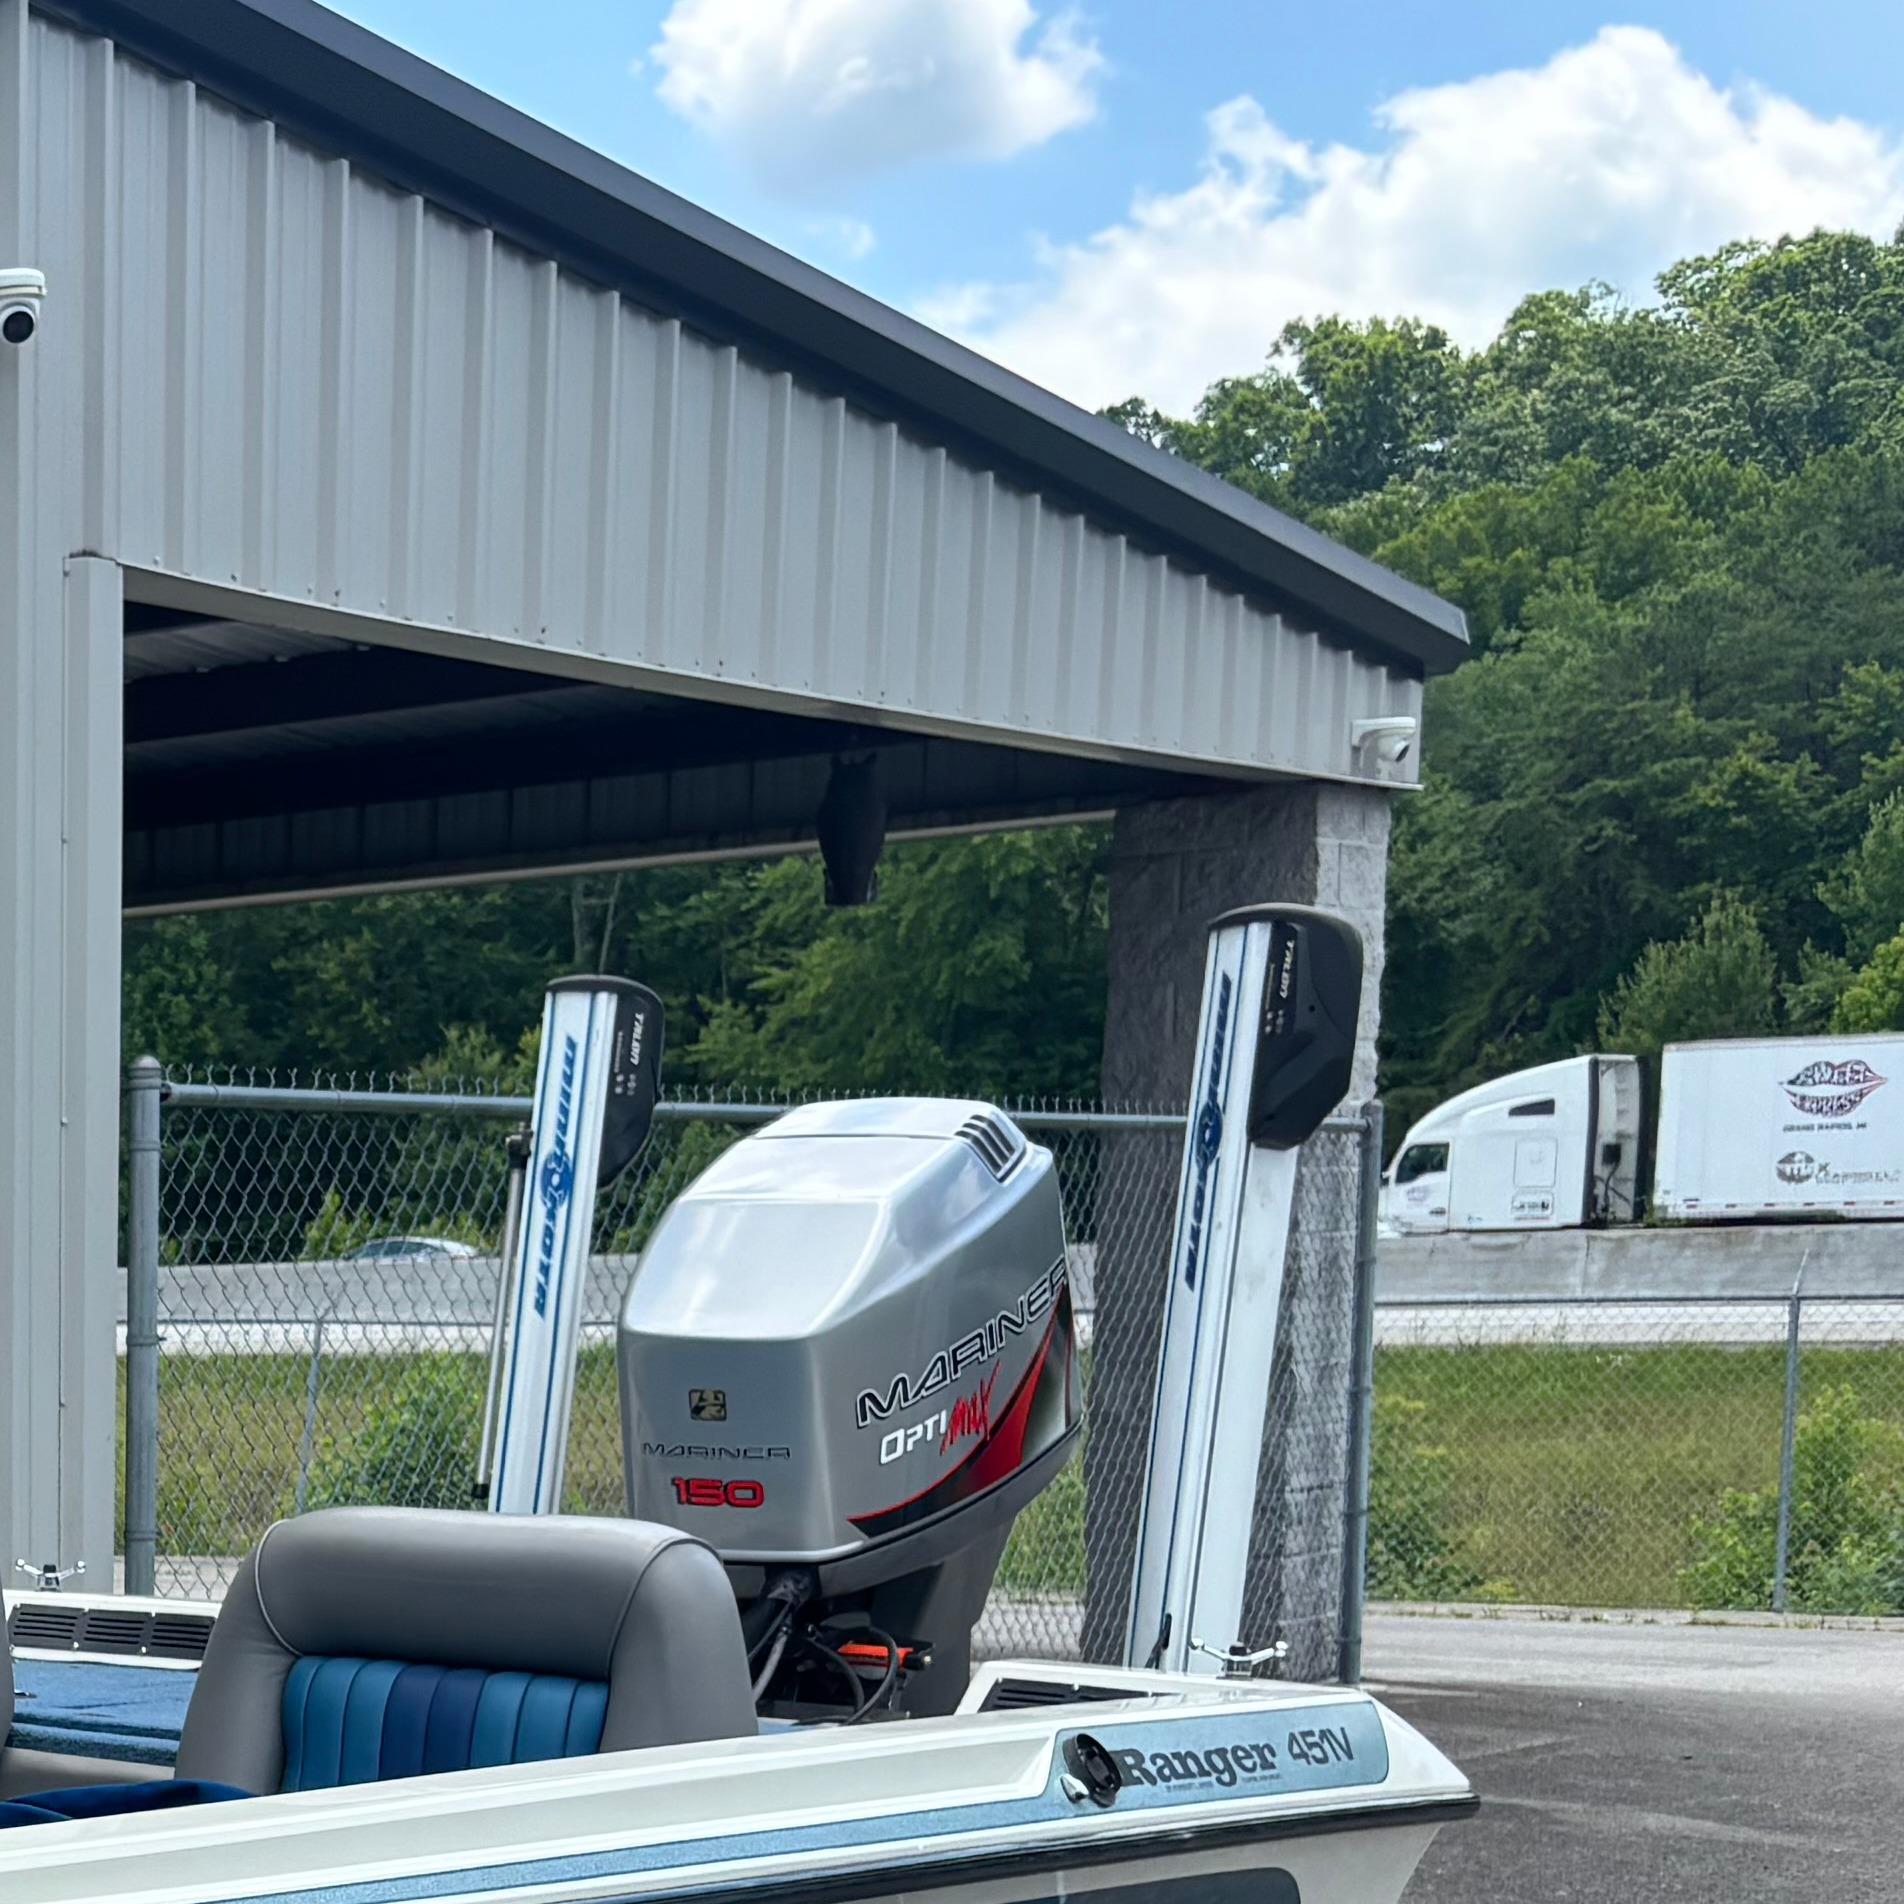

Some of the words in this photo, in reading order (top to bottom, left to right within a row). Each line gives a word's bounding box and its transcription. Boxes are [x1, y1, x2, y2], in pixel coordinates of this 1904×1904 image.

[856, 1253, 1068, 1428] MARINER
[642, 1442, 791, 1461] MARINER
[671, 1475, 765, 1508] 150
[1116, 1741, 1277, 1787] Ranger
[1287, 1727, 1354, 1766] 451V
